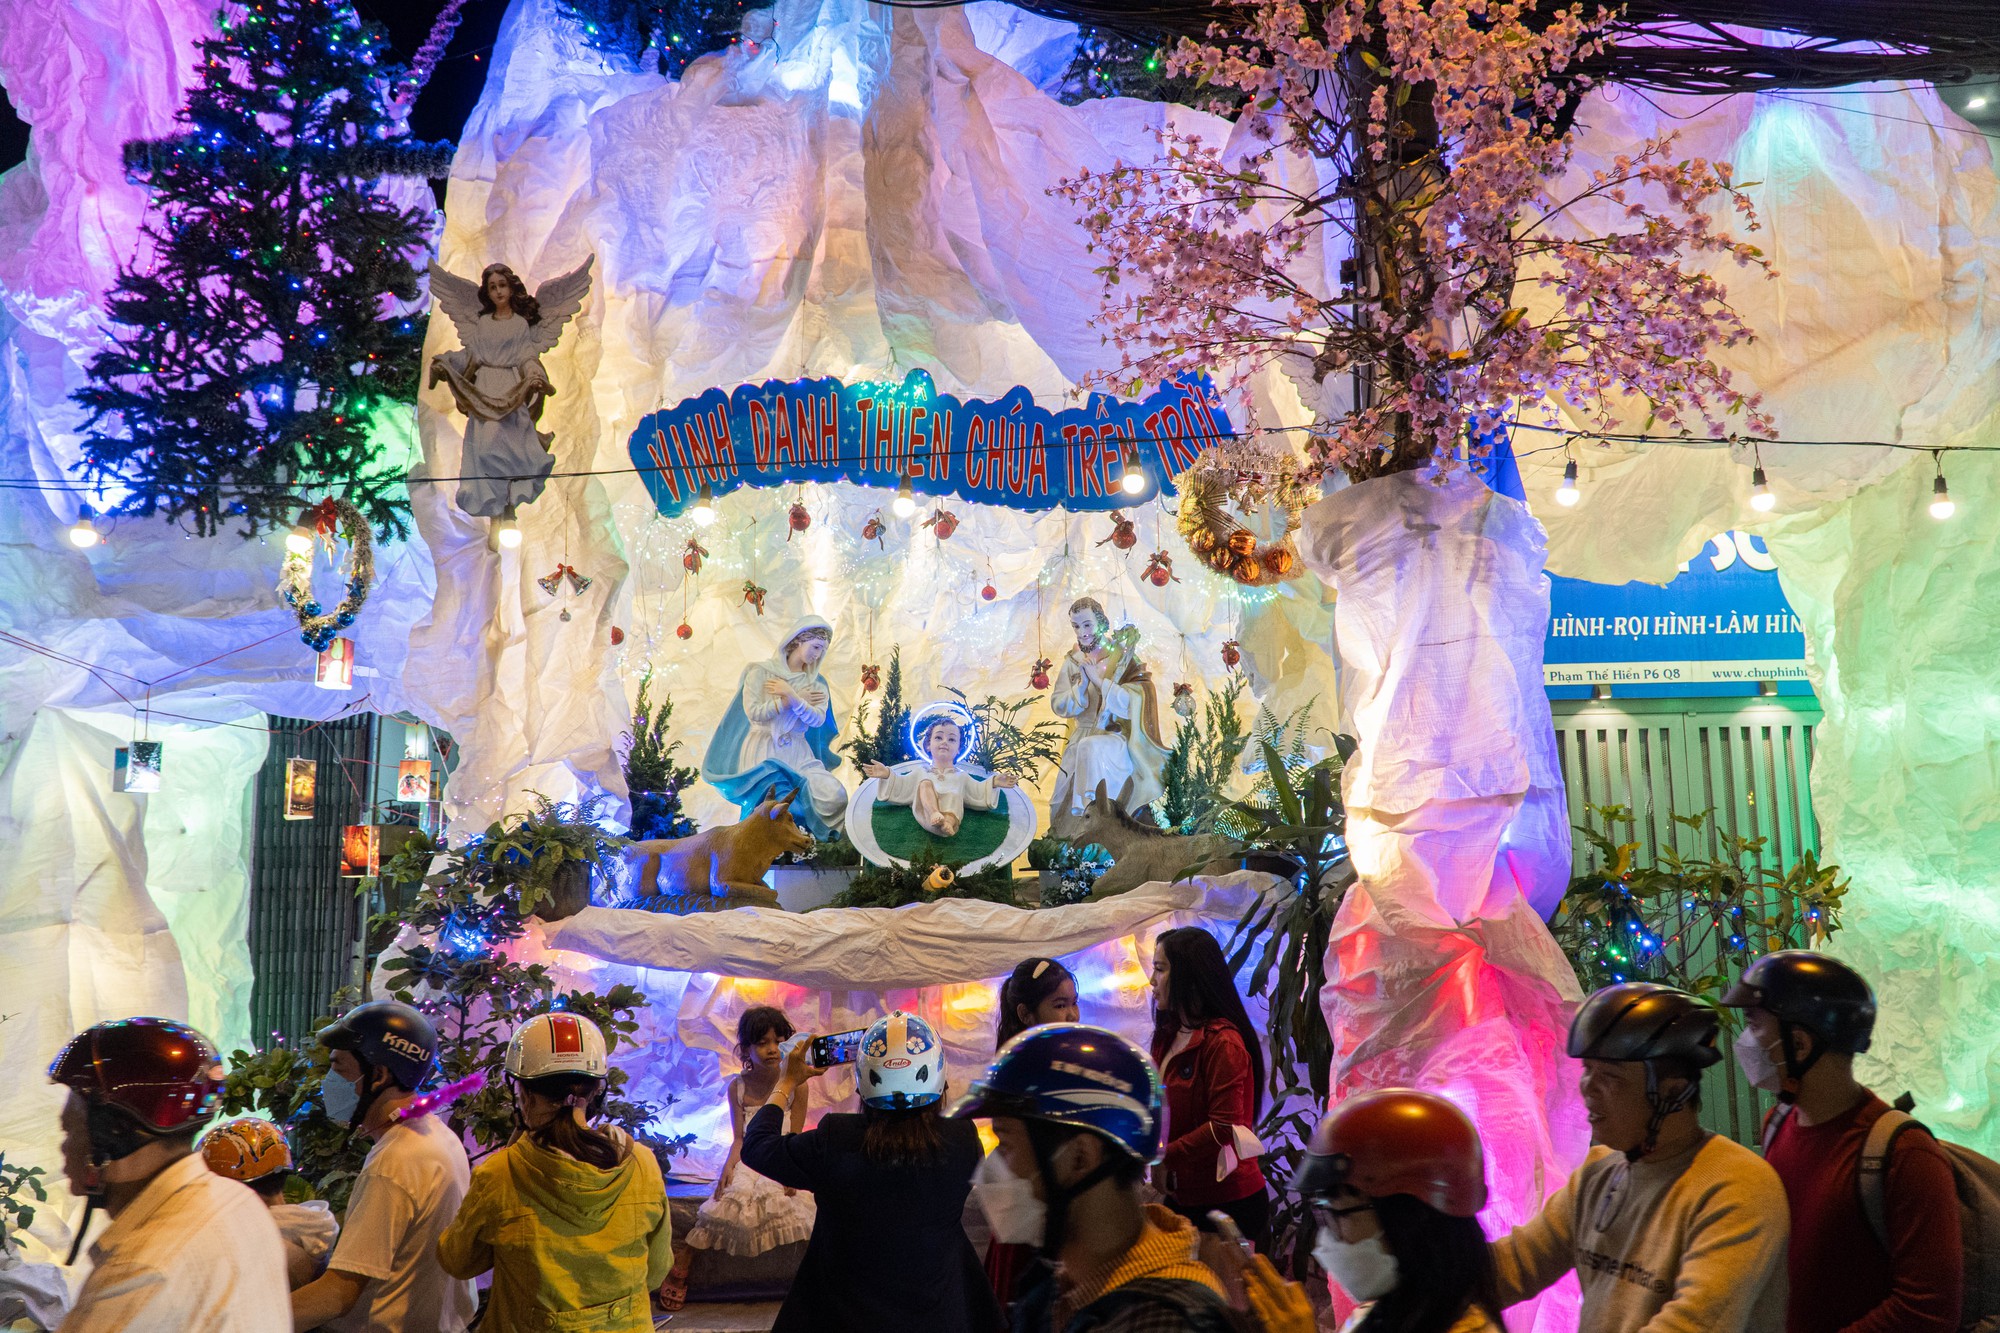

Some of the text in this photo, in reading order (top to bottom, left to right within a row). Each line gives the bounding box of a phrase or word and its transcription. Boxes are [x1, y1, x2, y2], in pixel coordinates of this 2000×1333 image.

[647, 402, 739, 503] VINH
[748, 391, 840, 474] DANH
[855, 384, 953, 482] THIÊN
[965, 402, 1049, 498] CHÚA
[1061, 402, 1143, 498] TRÊN
[1549, 671, 1583, 683] Phạm
[1586, 668, 1609, 681] Thế
[1643, 668, 1659, 680] P6
[1663, 668, 1681, 680] Q8
